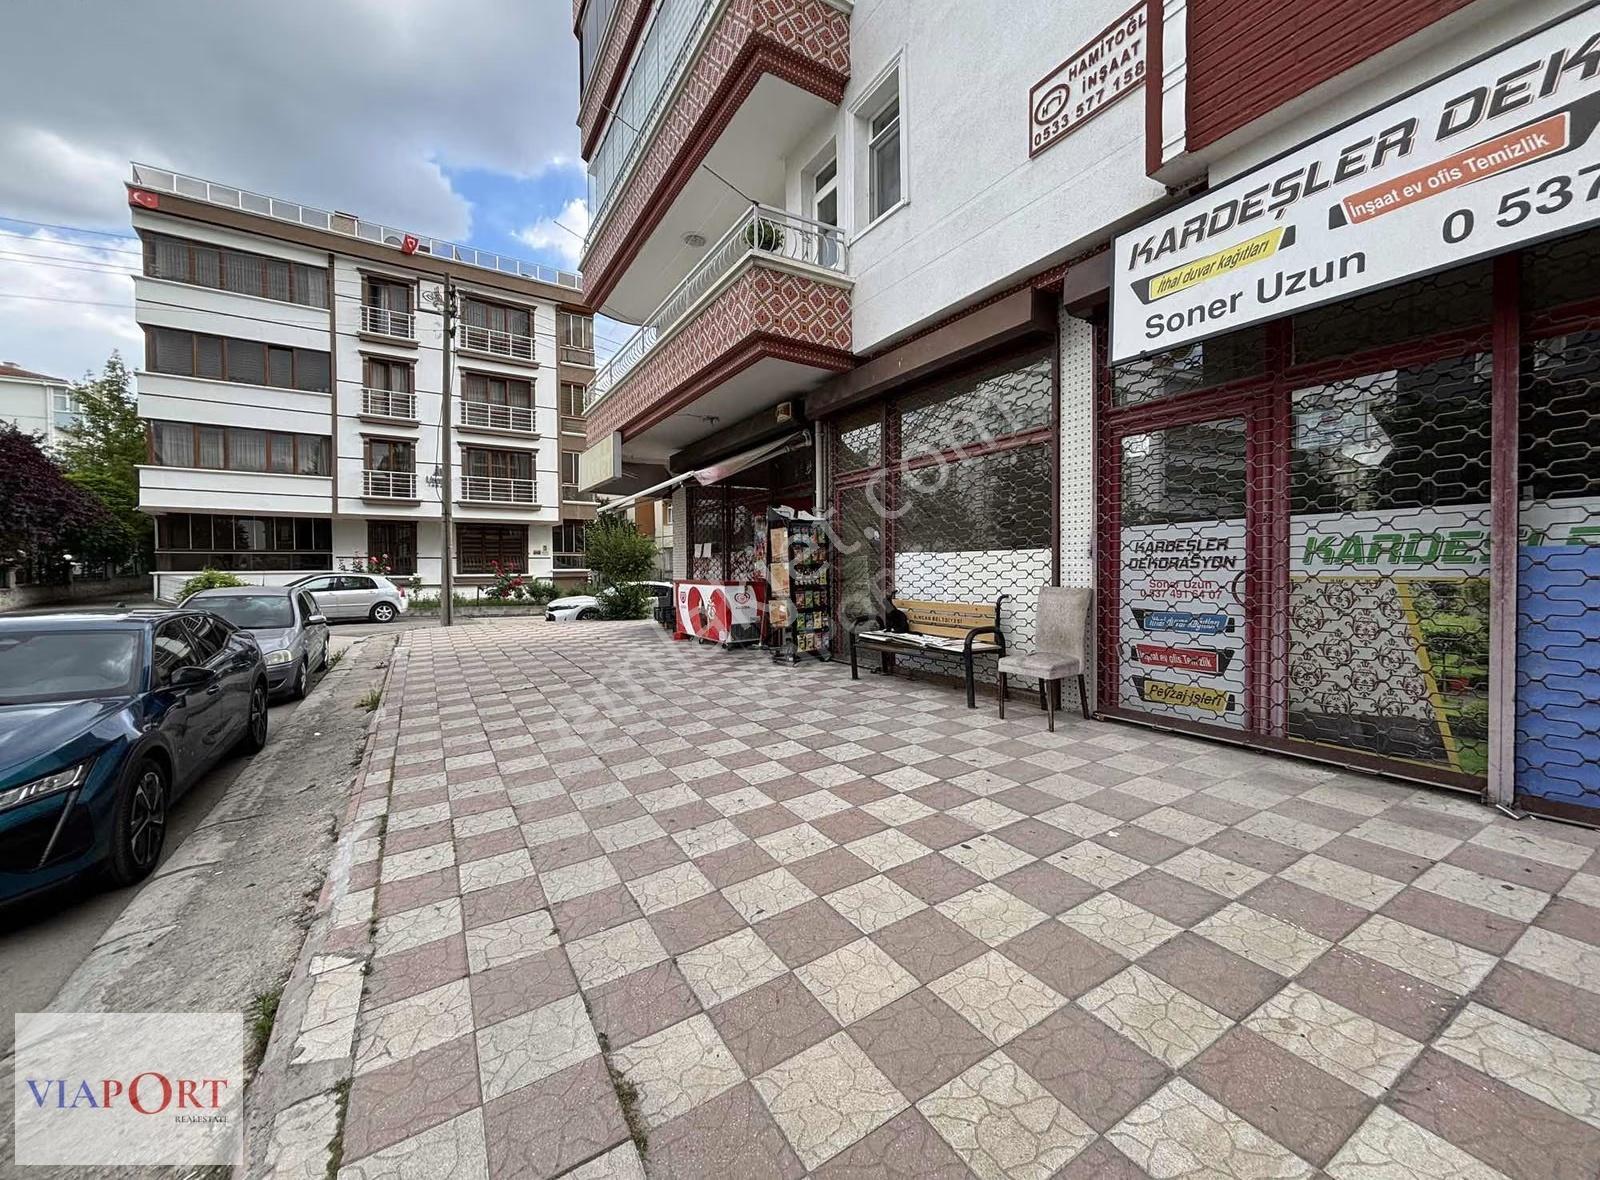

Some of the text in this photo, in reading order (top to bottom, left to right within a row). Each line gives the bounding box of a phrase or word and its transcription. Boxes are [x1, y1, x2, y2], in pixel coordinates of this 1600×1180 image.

[1082, 39, 1141, 94] İNŞAAT
[1034, 60, 1144, 147] 0533 577 158
[1128, 117, 1419, 271] KARDEŞLER
[1349, 133, 1549, 218] İnşaat ev ofis Temizlik
[1442, 163, 1600, 244] 0 537
[1145, 251, 1366, 339] Soner Uzun
[1182, 261, 1215, 285] duvar
[1217, 239, 1269, 273] kağıtları
[1129, 556, 1237, 569] DEKORASYON
[1208, 590, 1222, 599] 07
[1149, 684, 1188, 702] Peyzaj
